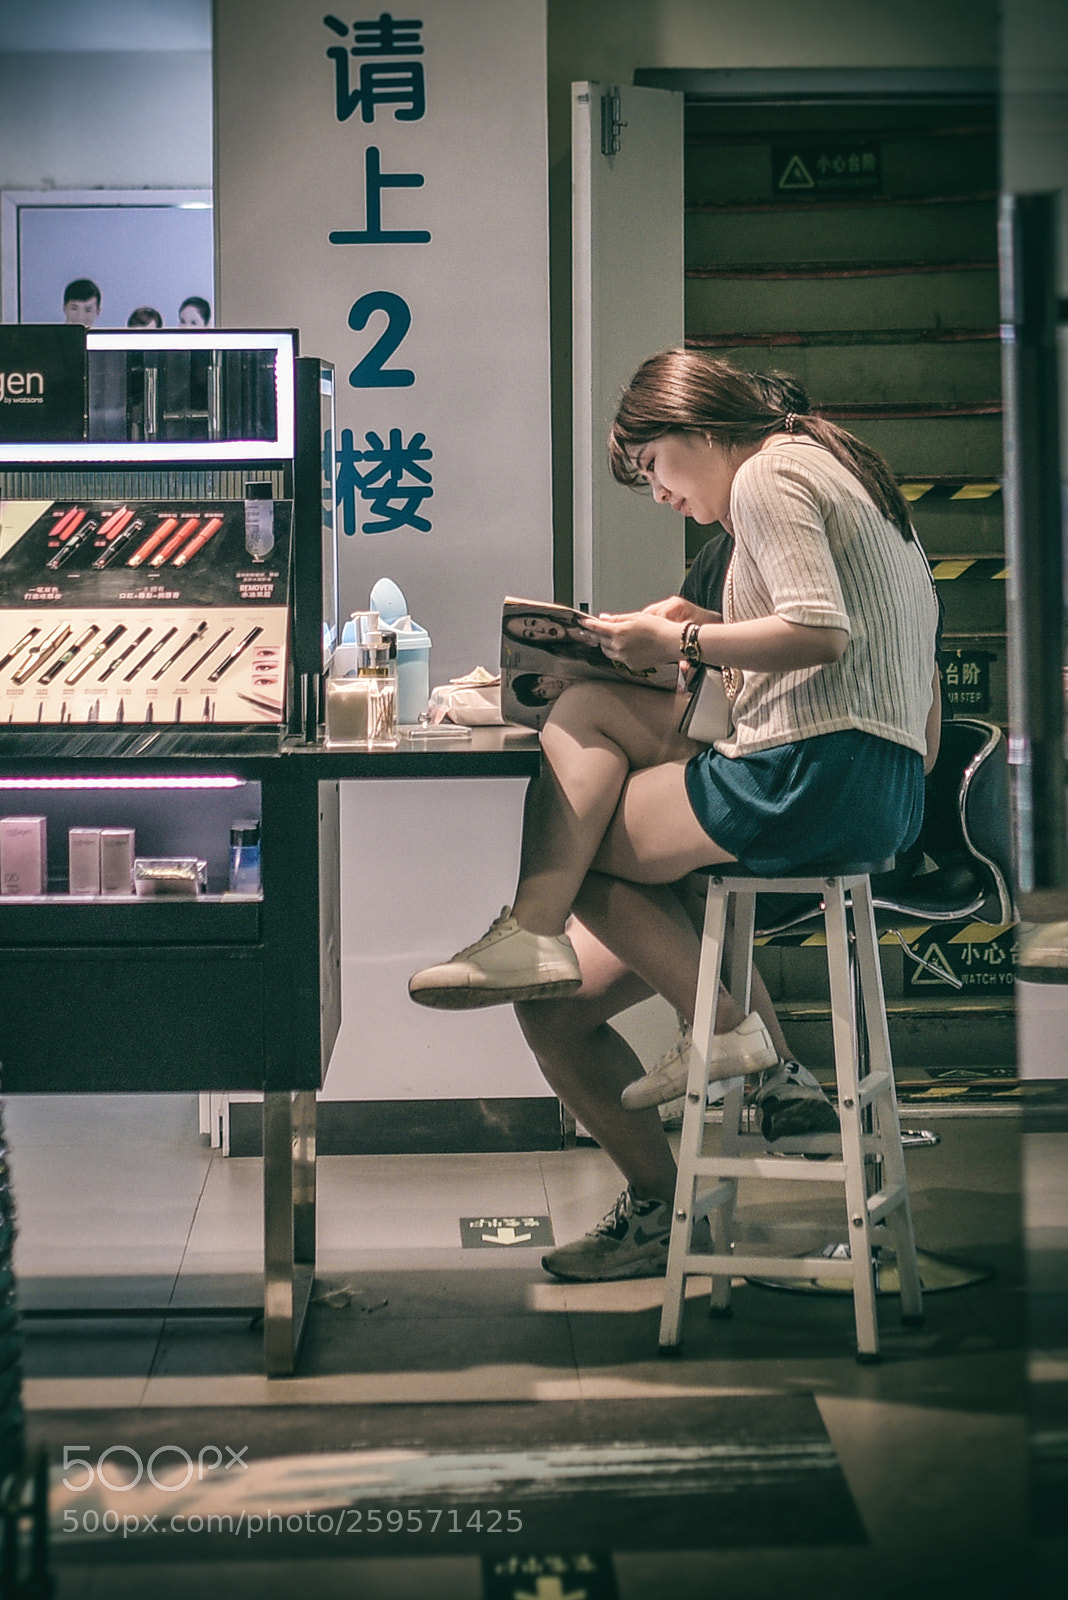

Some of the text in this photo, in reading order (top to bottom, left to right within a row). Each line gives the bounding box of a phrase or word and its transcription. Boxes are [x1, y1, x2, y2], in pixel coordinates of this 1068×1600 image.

[940, 662, 981, 685] 台阶
[960, 692, 982, 703] STEP
[960, 973, 997, 985] WATCH
